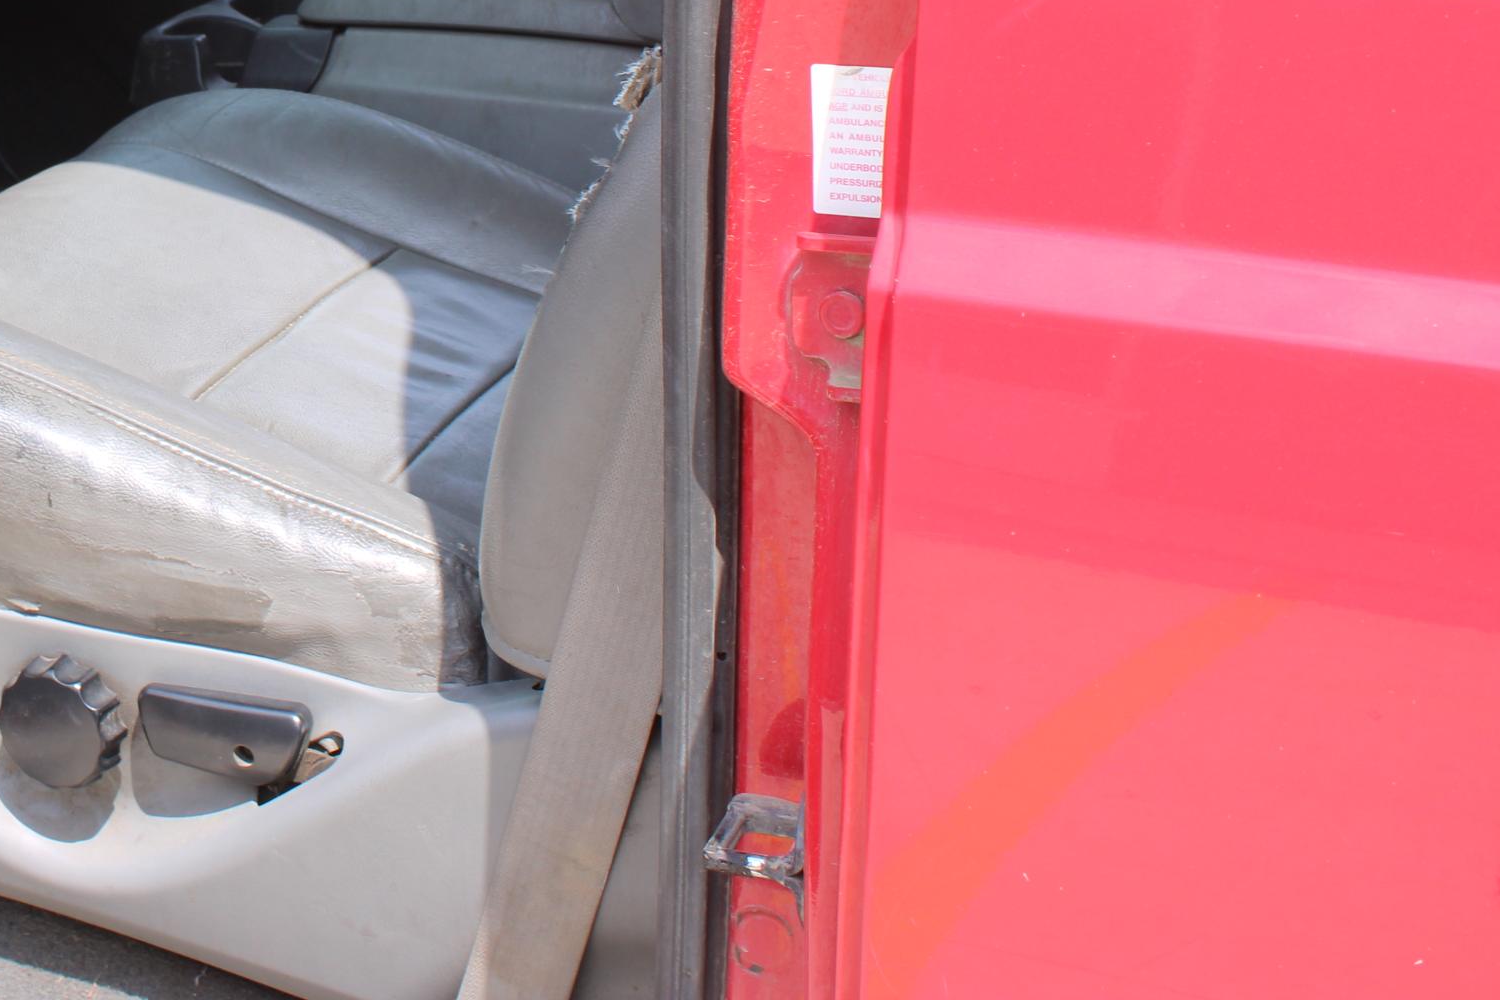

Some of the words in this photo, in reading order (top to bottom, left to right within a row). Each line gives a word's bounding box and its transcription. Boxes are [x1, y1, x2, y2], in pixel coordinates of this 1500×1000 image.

[850, 103, 872, 112] AND
[874, 104, 884, 113] IS
[828, 131, 844, 140] AN
[829, 146, 883, 157] WARRANTY
